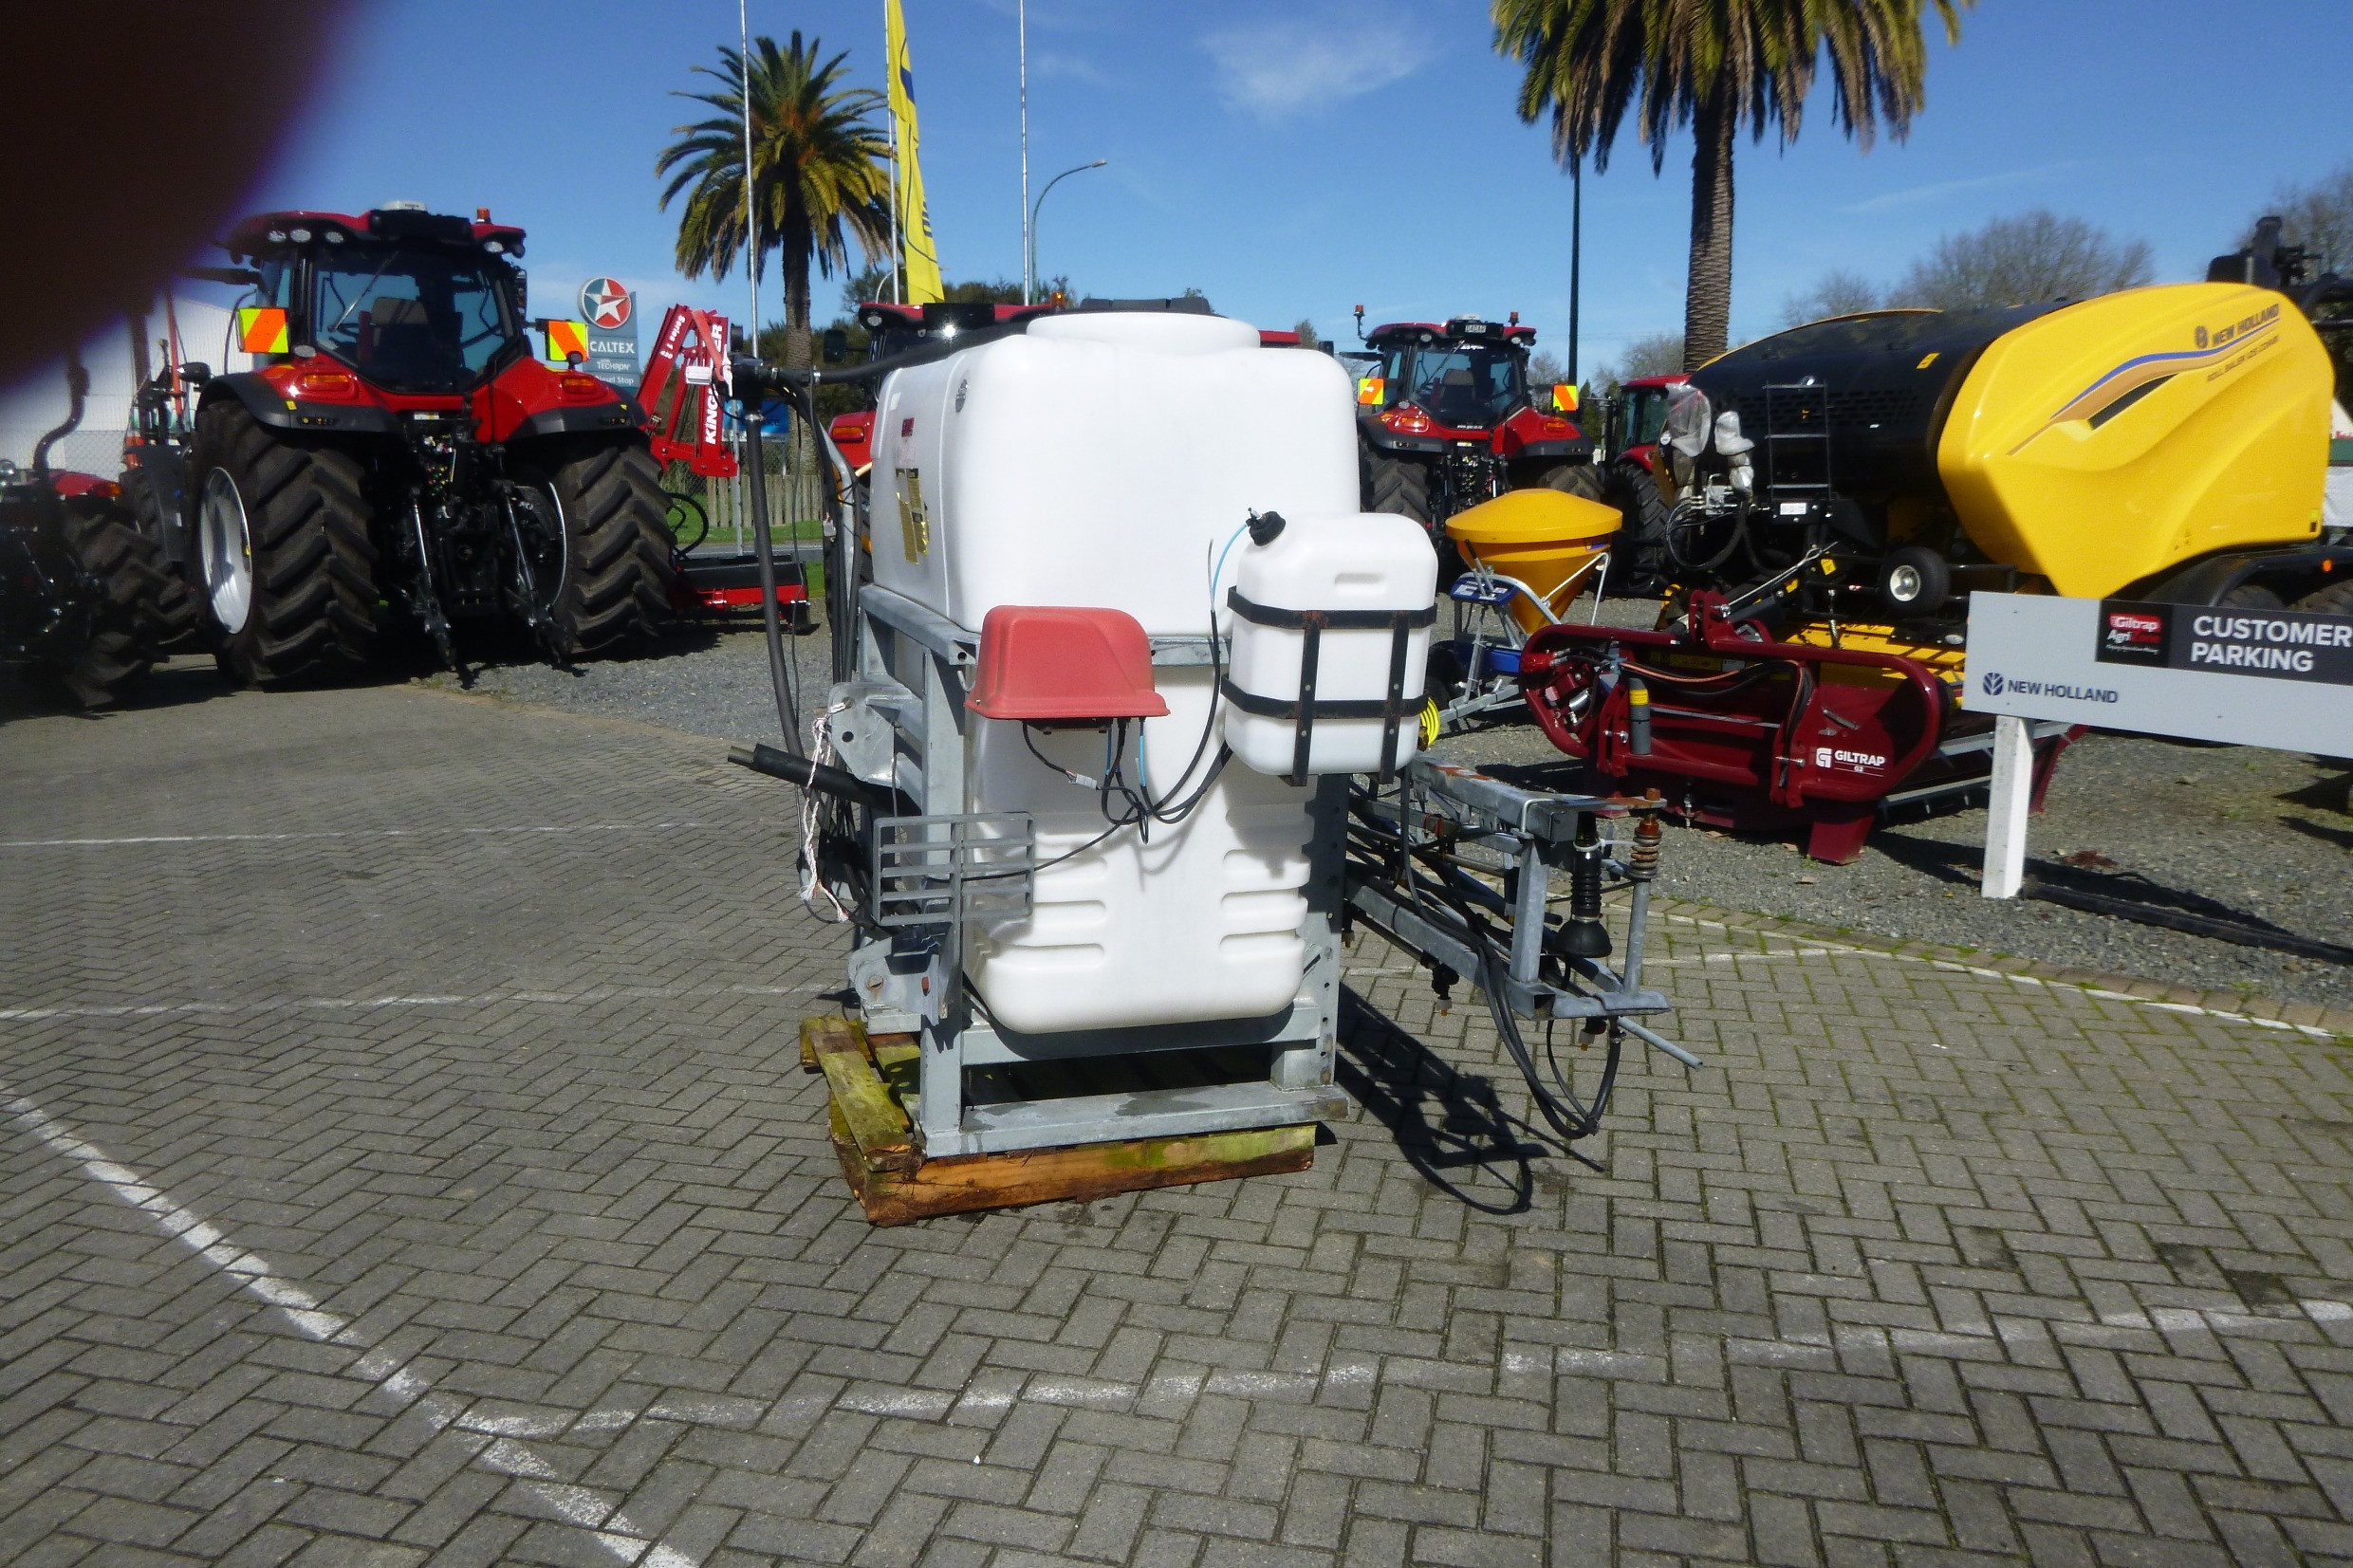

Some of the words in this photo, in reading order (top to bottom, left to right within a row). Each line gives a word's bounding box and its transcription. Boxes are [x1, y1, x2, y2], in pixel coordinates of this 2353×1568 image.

[2212, 323, 2235, 347] NEW
[2237, 303, 2280, 335] HOLLAND
[589, 341, 635, 354] CALTEX
[597, 361, 629, 371] TECHRON
[2193, 615, 2353, 648] CUSTOMER
[2190, 641, 2315, 673] PARKING
[2008, 679, 2042, 695] NEW
[2044, 683, 2119, 704] HOLLAND
[1834, 749, 1886, 766] GILTRAP
